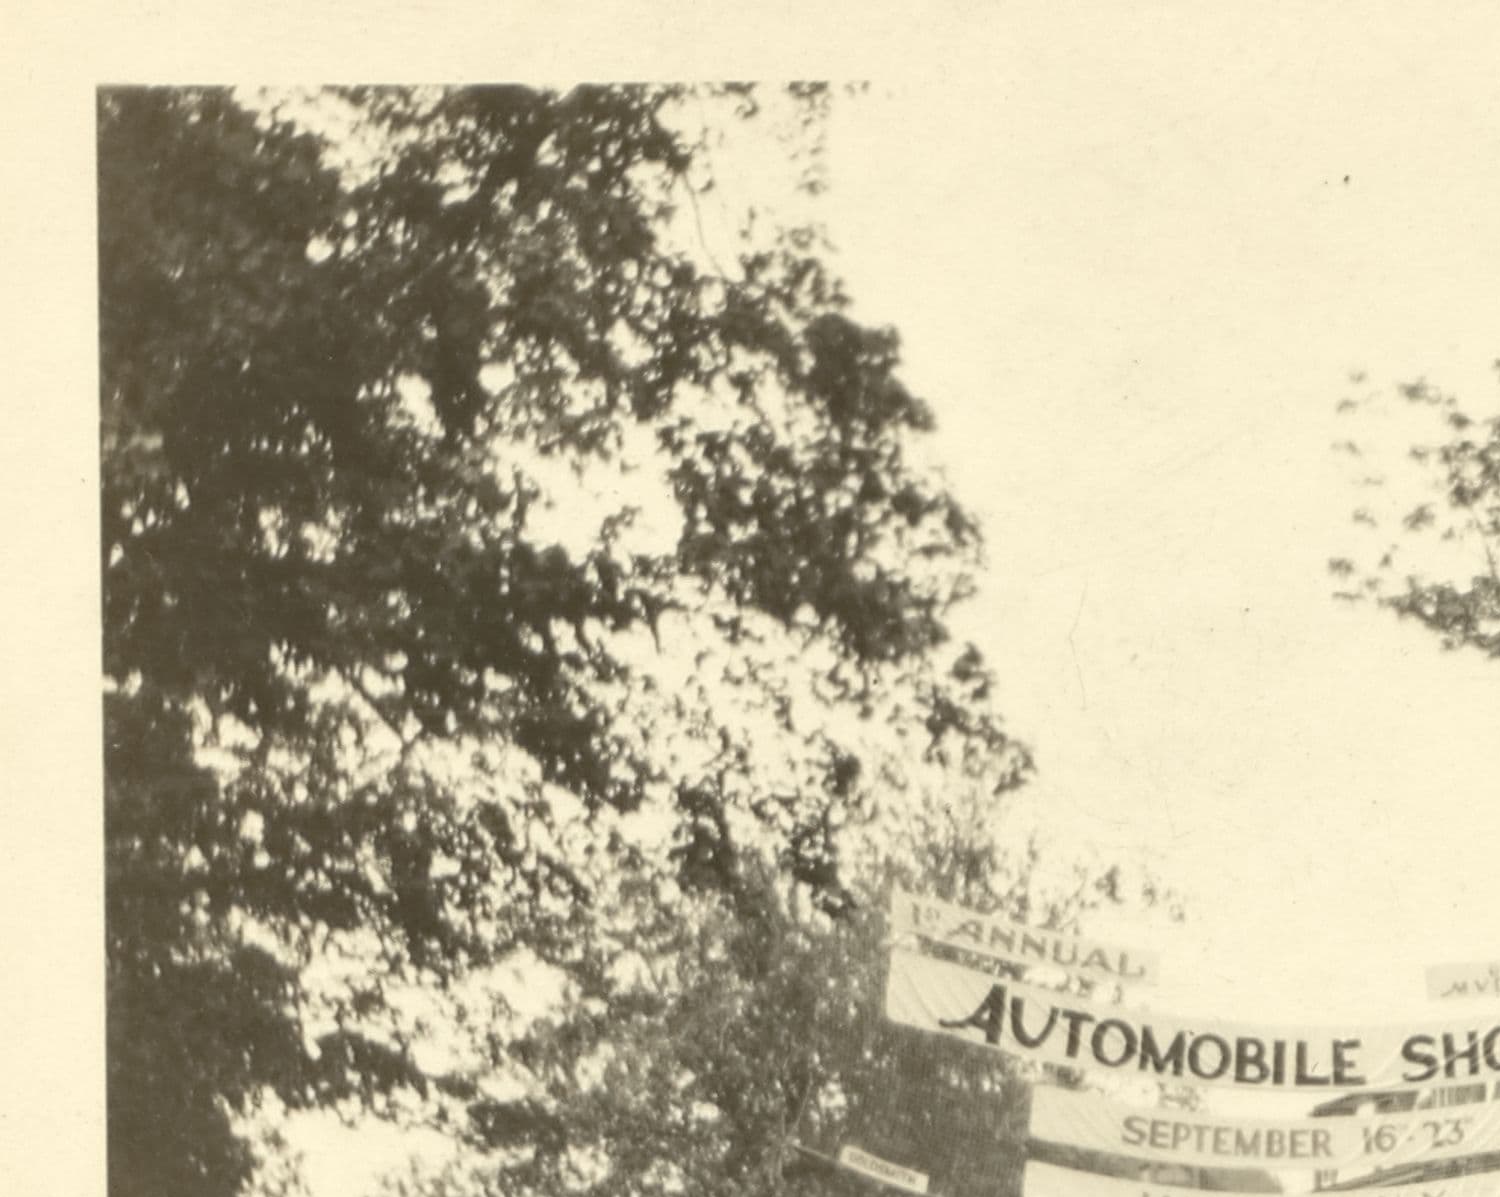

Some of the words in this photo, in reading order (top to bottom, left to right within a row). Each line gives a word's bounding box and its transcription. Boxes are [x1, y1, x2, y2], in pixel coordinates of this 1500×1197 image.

[946, 917, 1146, 979] ANNUAL
[938, 983, 1366, 1086] AUTOMOBILE
[1121, 1114, 1334, 1159] SEPTEMBER
